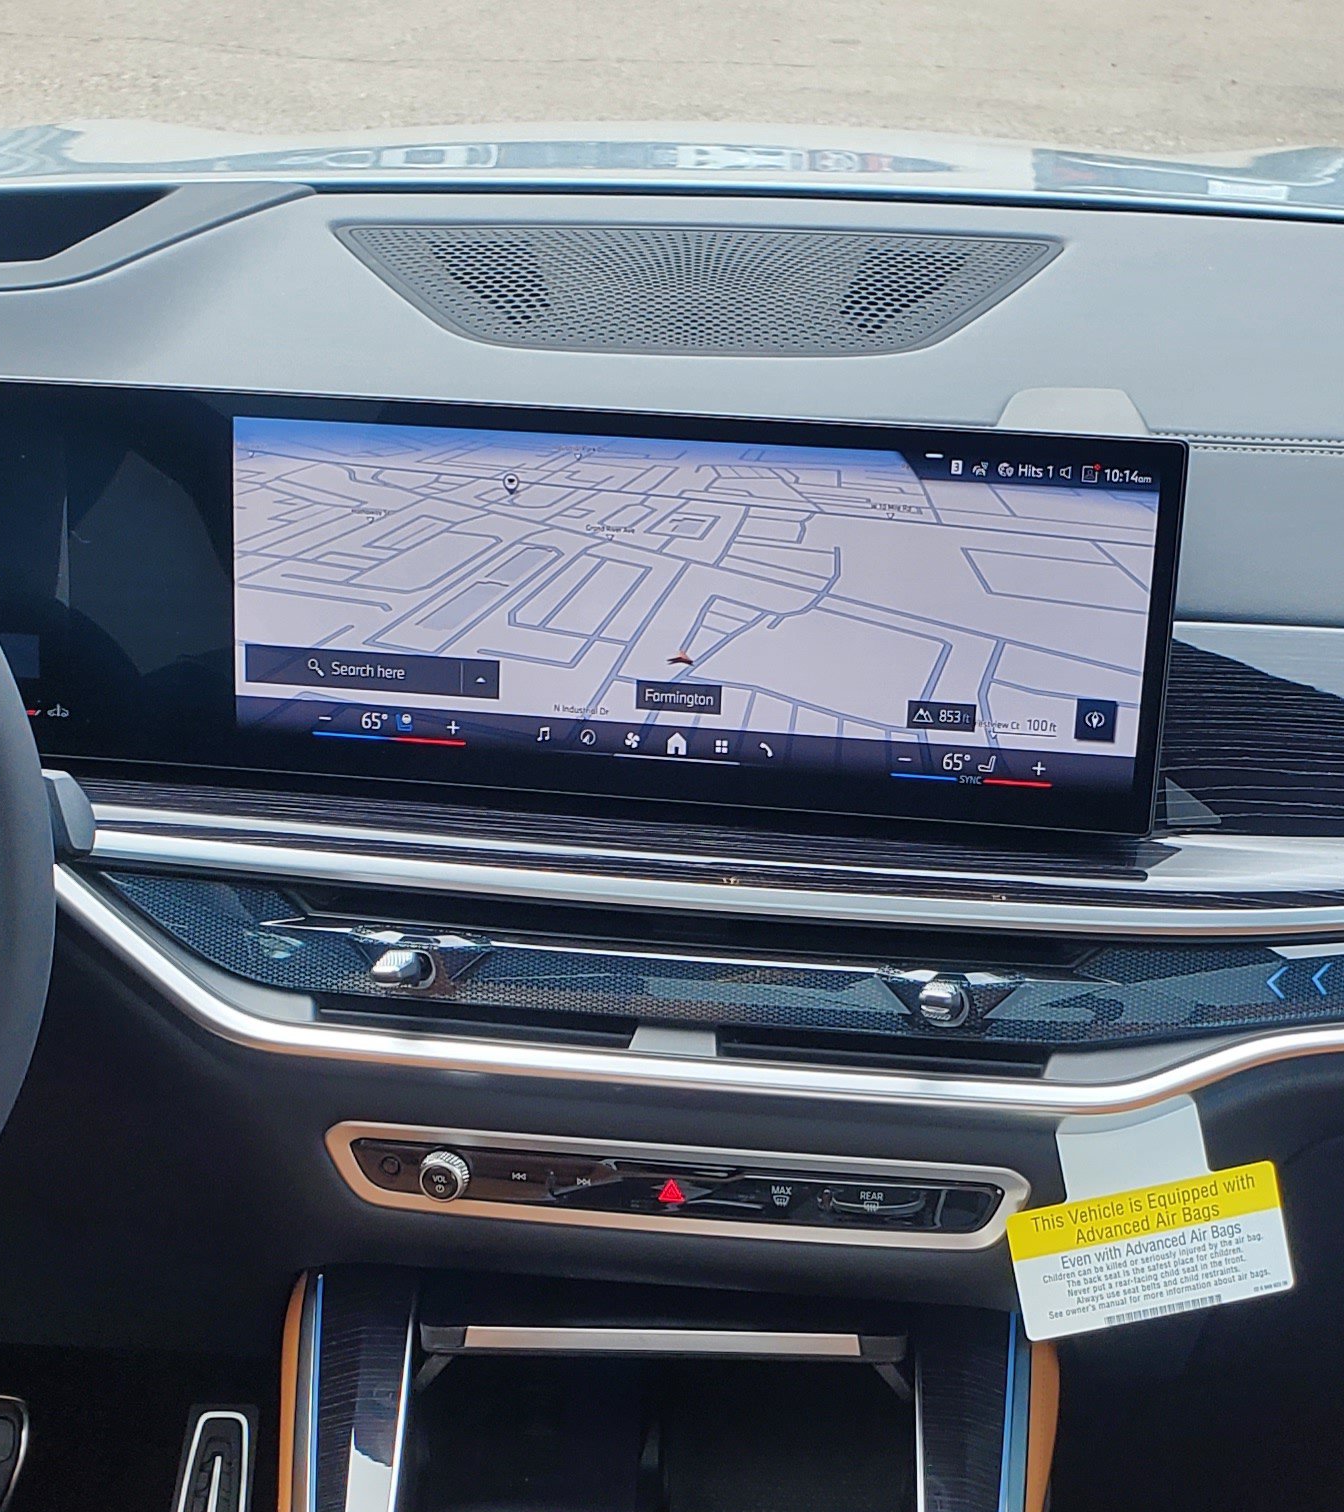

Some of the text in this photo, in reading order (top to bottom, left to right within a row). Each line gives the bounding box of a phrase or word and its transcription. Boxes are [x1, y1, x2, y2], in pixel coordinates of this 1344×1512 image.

[1018, 464, 1044, 478] Hits
[331, 661, 406, 680] Search here
[645, 688, 714, 708] Farmington
[959, 775, 982, 785] SYNC
[432, 1175, 447, 1183] VOL
[771, 1185, 792, 1195] MAX
[859, 1191, 884, 1200] REAR
[1031, 1172, 1256, 1233] This Vehicle is Equipped with
[1074, 1201, 1221, 1244] Advanced Air Bags
[1042, 1232, 1263, 1284] Children can be killed or seriously injured by the air bag.
[1061, 1221, 1243, 1269] Even with Advanced Air Bags
[1067, 1246, 1244, 1288] The back seat is the safest place for children.
[1067, 1286, 1090, 1297] Never
[1092, 1283, 1106, 1293] put
[1115, 1273, 1158, 1288] rear-facing
[1160, 1268, 1180, 1279] child
[1182, 1264, 1199, 1274] seat
[1200, 1262, 1208, 1270] in
[1210, 1259, 1223, 1268] the
[1225, 1255, 1246, 1265] front.
[1076, 1265, 1240, 1306] Always use seat belts and child restraints.
[1048, 1268, 1271, 1320] See owner's manual for more information about air bags.
